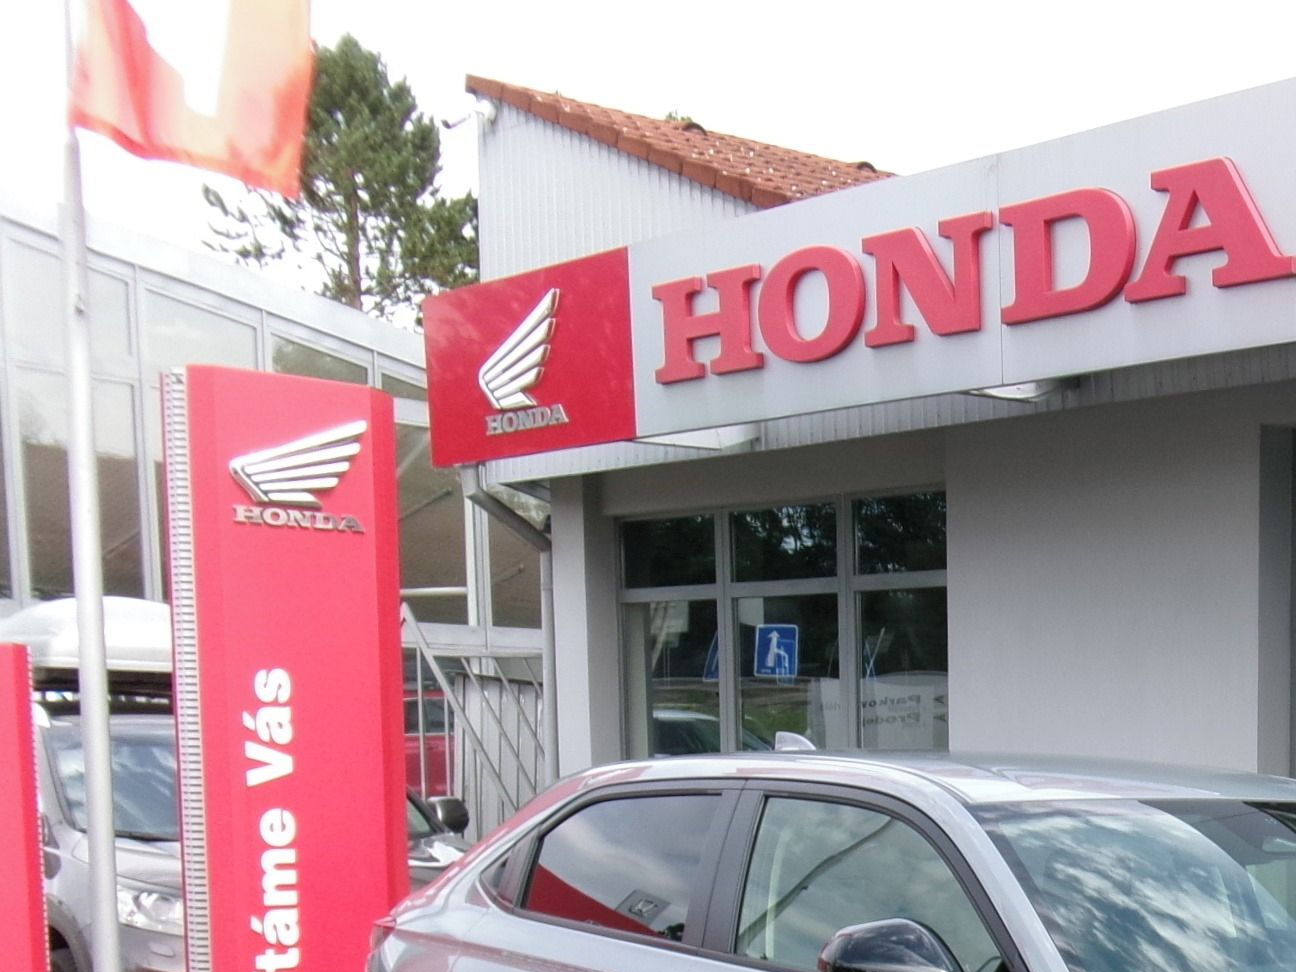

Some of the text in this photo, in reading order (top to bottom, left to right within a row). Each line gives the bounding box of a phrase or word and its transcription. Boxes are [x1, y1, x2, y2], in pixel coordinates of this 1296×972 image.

[486, 404, 569, 435] HONDA
[233, 505, 365, 534] HONDA
[242, 668, 294, 787] Vás
